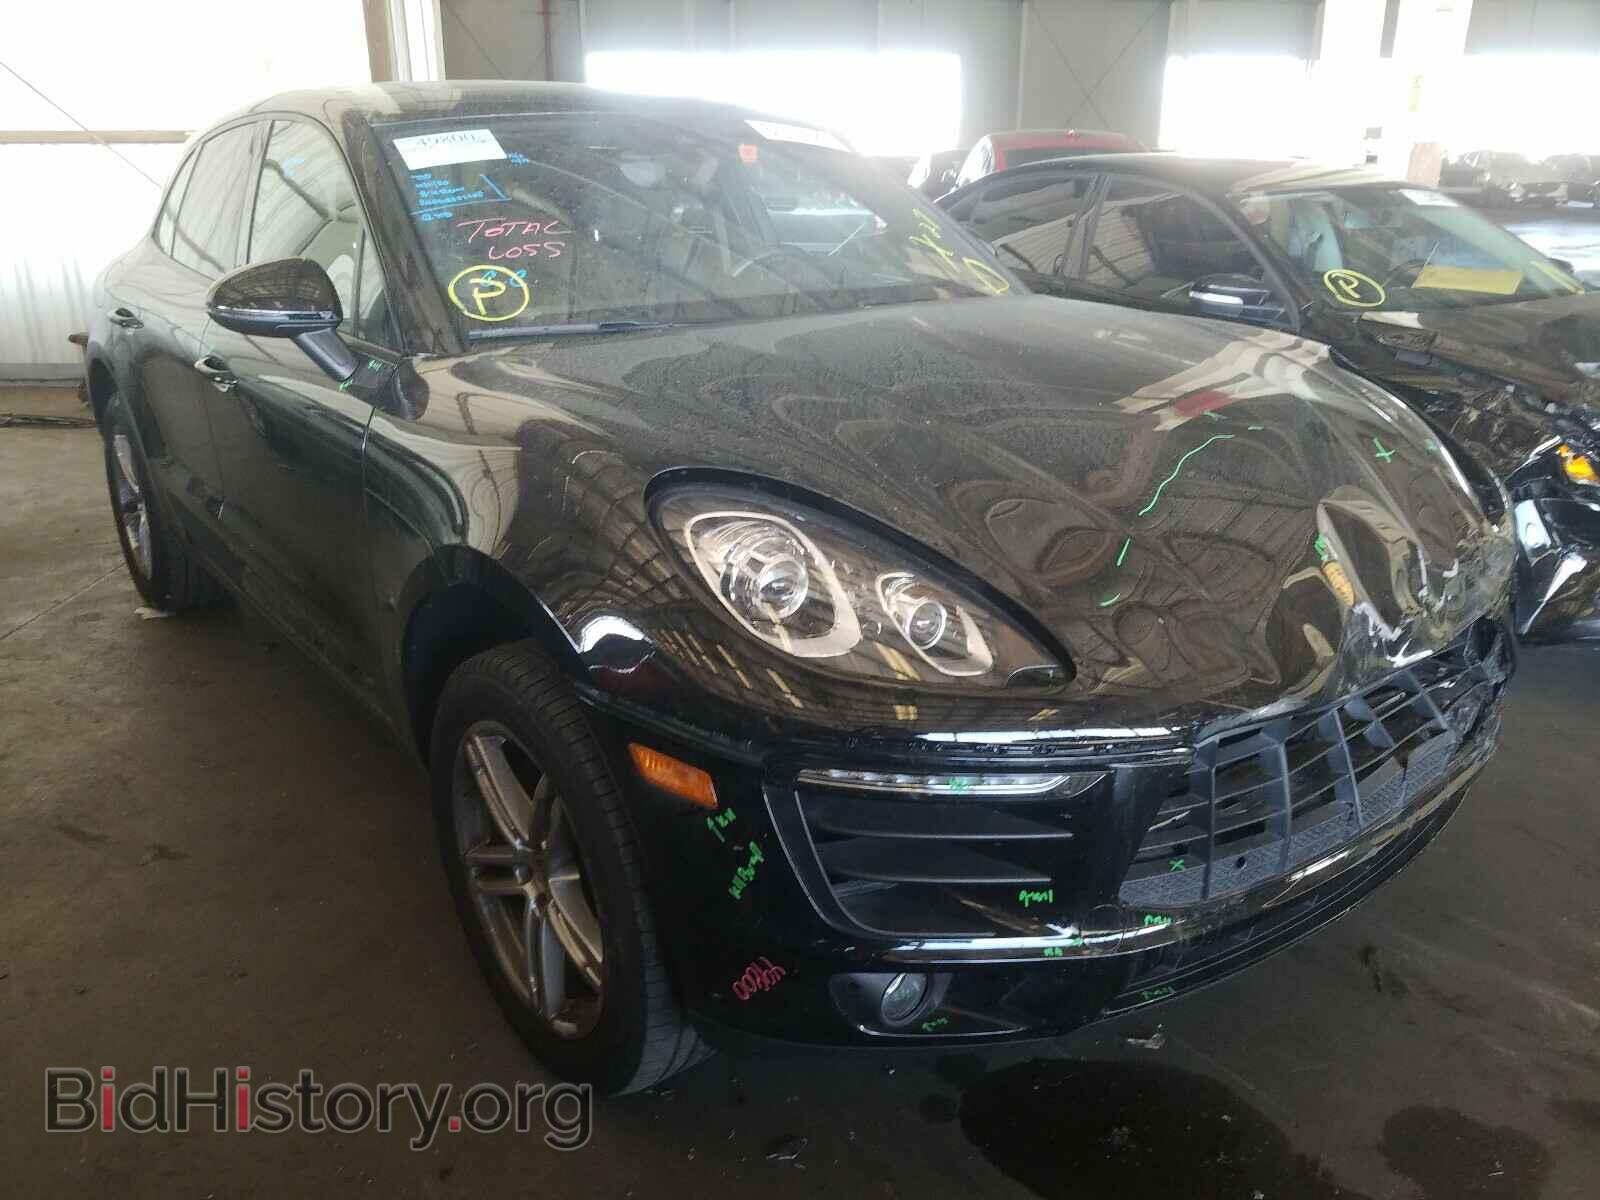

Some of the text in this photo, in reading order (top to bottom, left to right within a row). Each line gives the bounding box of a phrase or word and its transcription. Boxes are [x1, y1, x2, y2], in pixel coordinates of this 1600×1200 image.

[488, 241, 566, 260] LOSS
[469, 277, 507, 316] P
[1330, 271, 1361, 299] P
